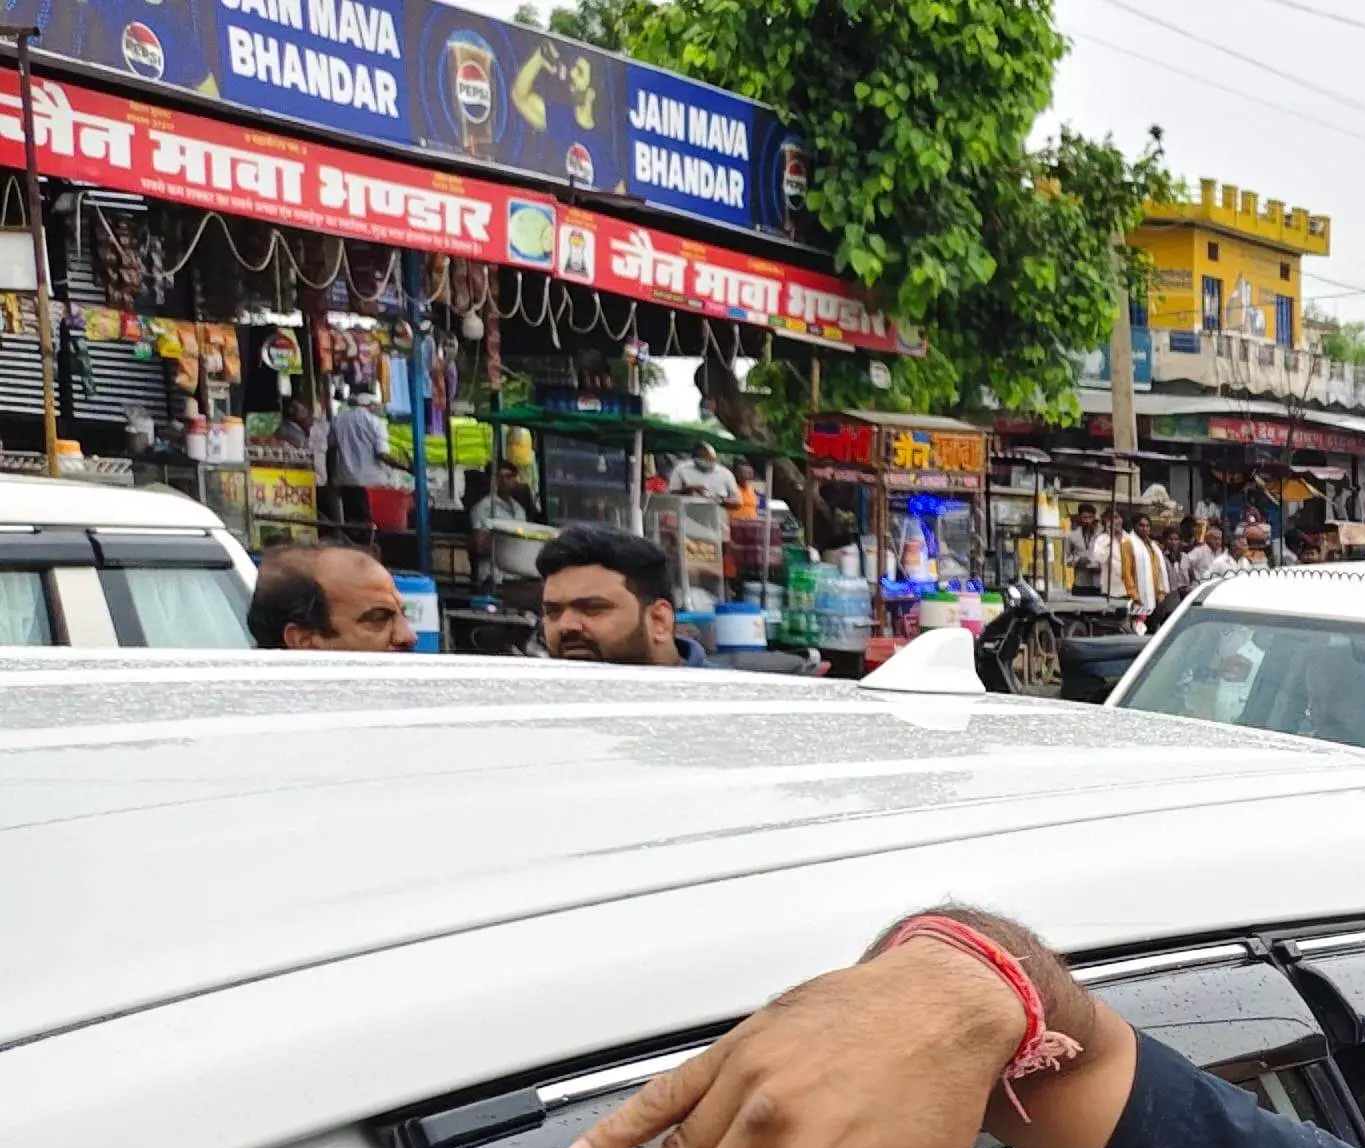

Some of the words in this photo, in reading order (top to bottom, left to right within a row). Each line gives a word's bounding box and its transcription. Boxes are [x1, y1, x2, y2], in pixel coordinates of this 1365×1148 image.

[308, 0, 401, 59] MAVA
[228, 25, 399, 119] BHANDAR
[459, 83, 490, 100] PEPSI
[629, 88, 686, 140] JAIN
[689, 107, 750, 161] MAVA
[0, 82, 135, 170] जैन
[149, 128, 305, 204] मावा
[318, 164, 493, 242] भण्डार
[635, 139, 745, 209] BHANDAR
[609, 229, 688, 294] जैन
[689, 259, 783, 314] मावा
